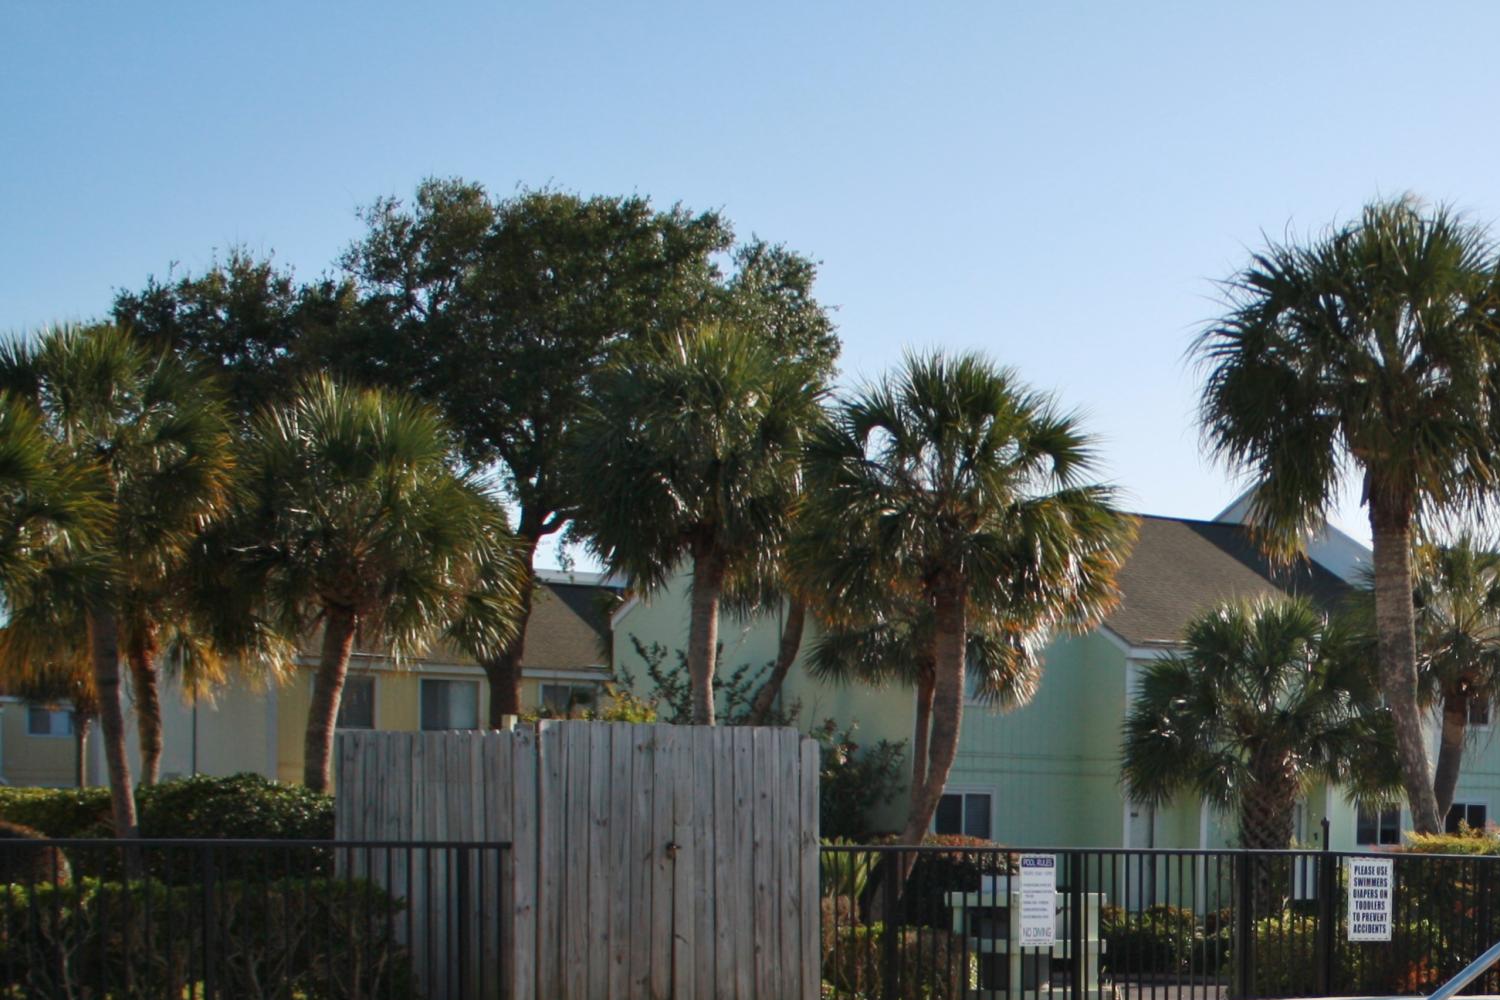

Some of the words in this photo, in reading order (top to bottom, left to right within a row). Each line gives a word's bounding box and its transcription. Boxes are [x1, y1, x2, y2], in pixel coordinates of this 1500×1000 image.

[1023, 858, 1036, 866] POOL
[1036, 858, 1053, 866] RULES
[1354, 865, 1375, 875] PLEASE
[1376, 866, 1388, 875] USE
[1354, 877, 1388, 887] SWIMMERS
[1353, 889, 1378, 898] DIAPERS
[1379, 889, 1388, 898] ON
[1355, 901, 1385, 910] TODDLERS
[1353, 912, 1361, 921] TO
[1361, 912, 1387, 921] PREVENT
[1023, 927, 1032, 937] NO
[1032, 927, 1052, 937] DIVING
[1353, 924, 1386, 934] ACCIDENTS
